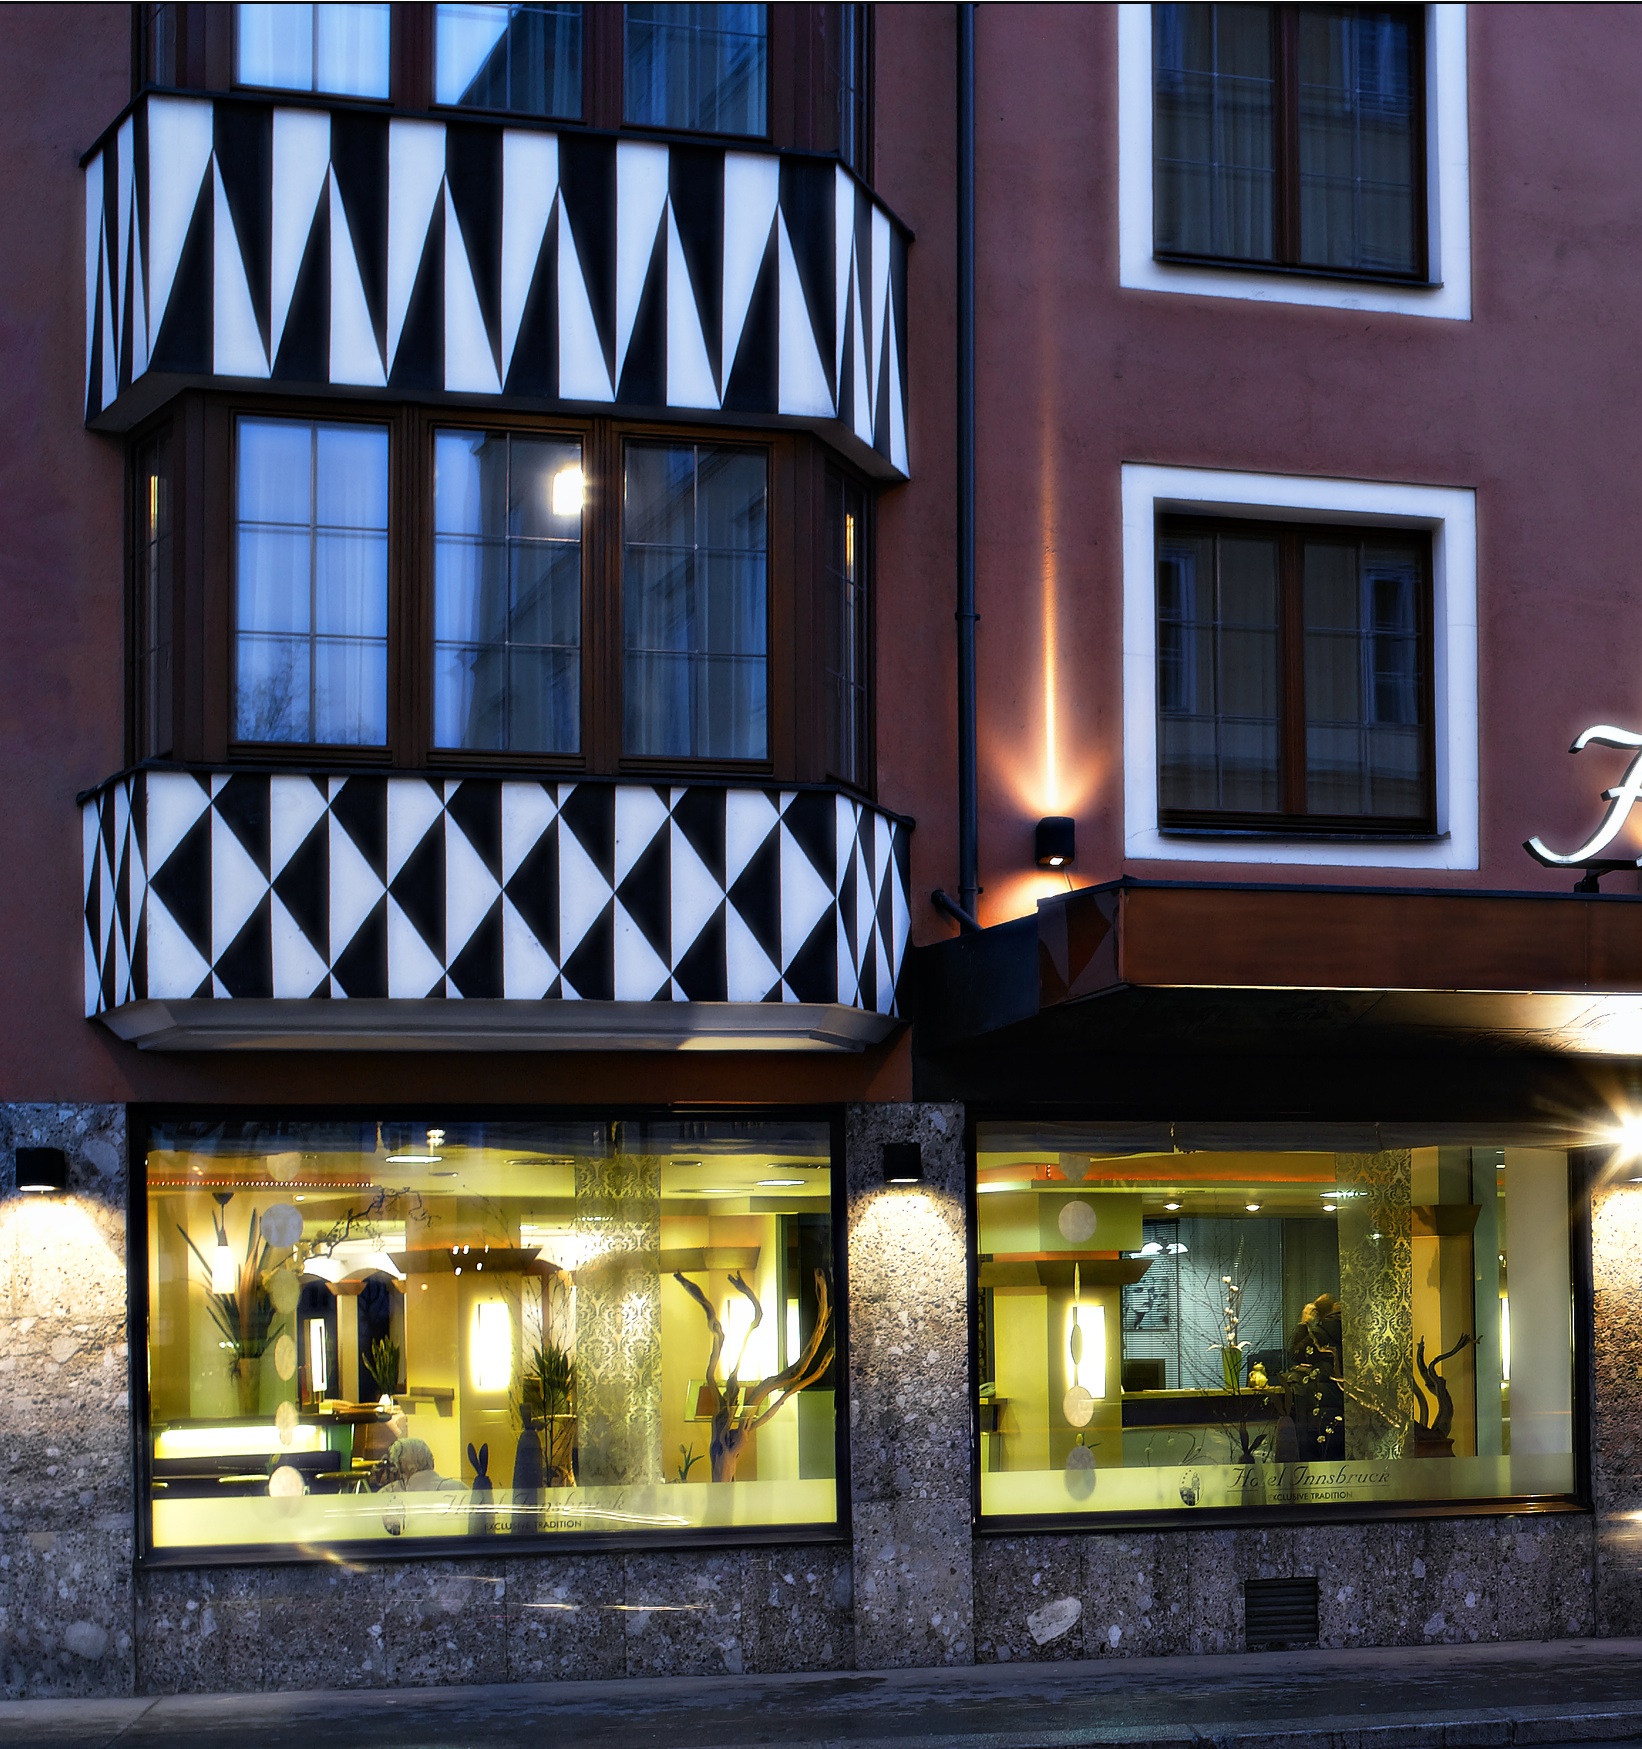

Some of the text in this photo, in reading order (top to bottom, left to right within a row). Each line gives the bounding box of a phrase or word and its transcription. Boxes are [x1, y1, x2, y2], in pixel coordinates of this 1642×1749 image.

[1291, 1464, 1390, 1487] Innsbruck
[1310, 1490, 1353, 1500] TRADITION
[535, 1519, 582, 1530] TRADITION
